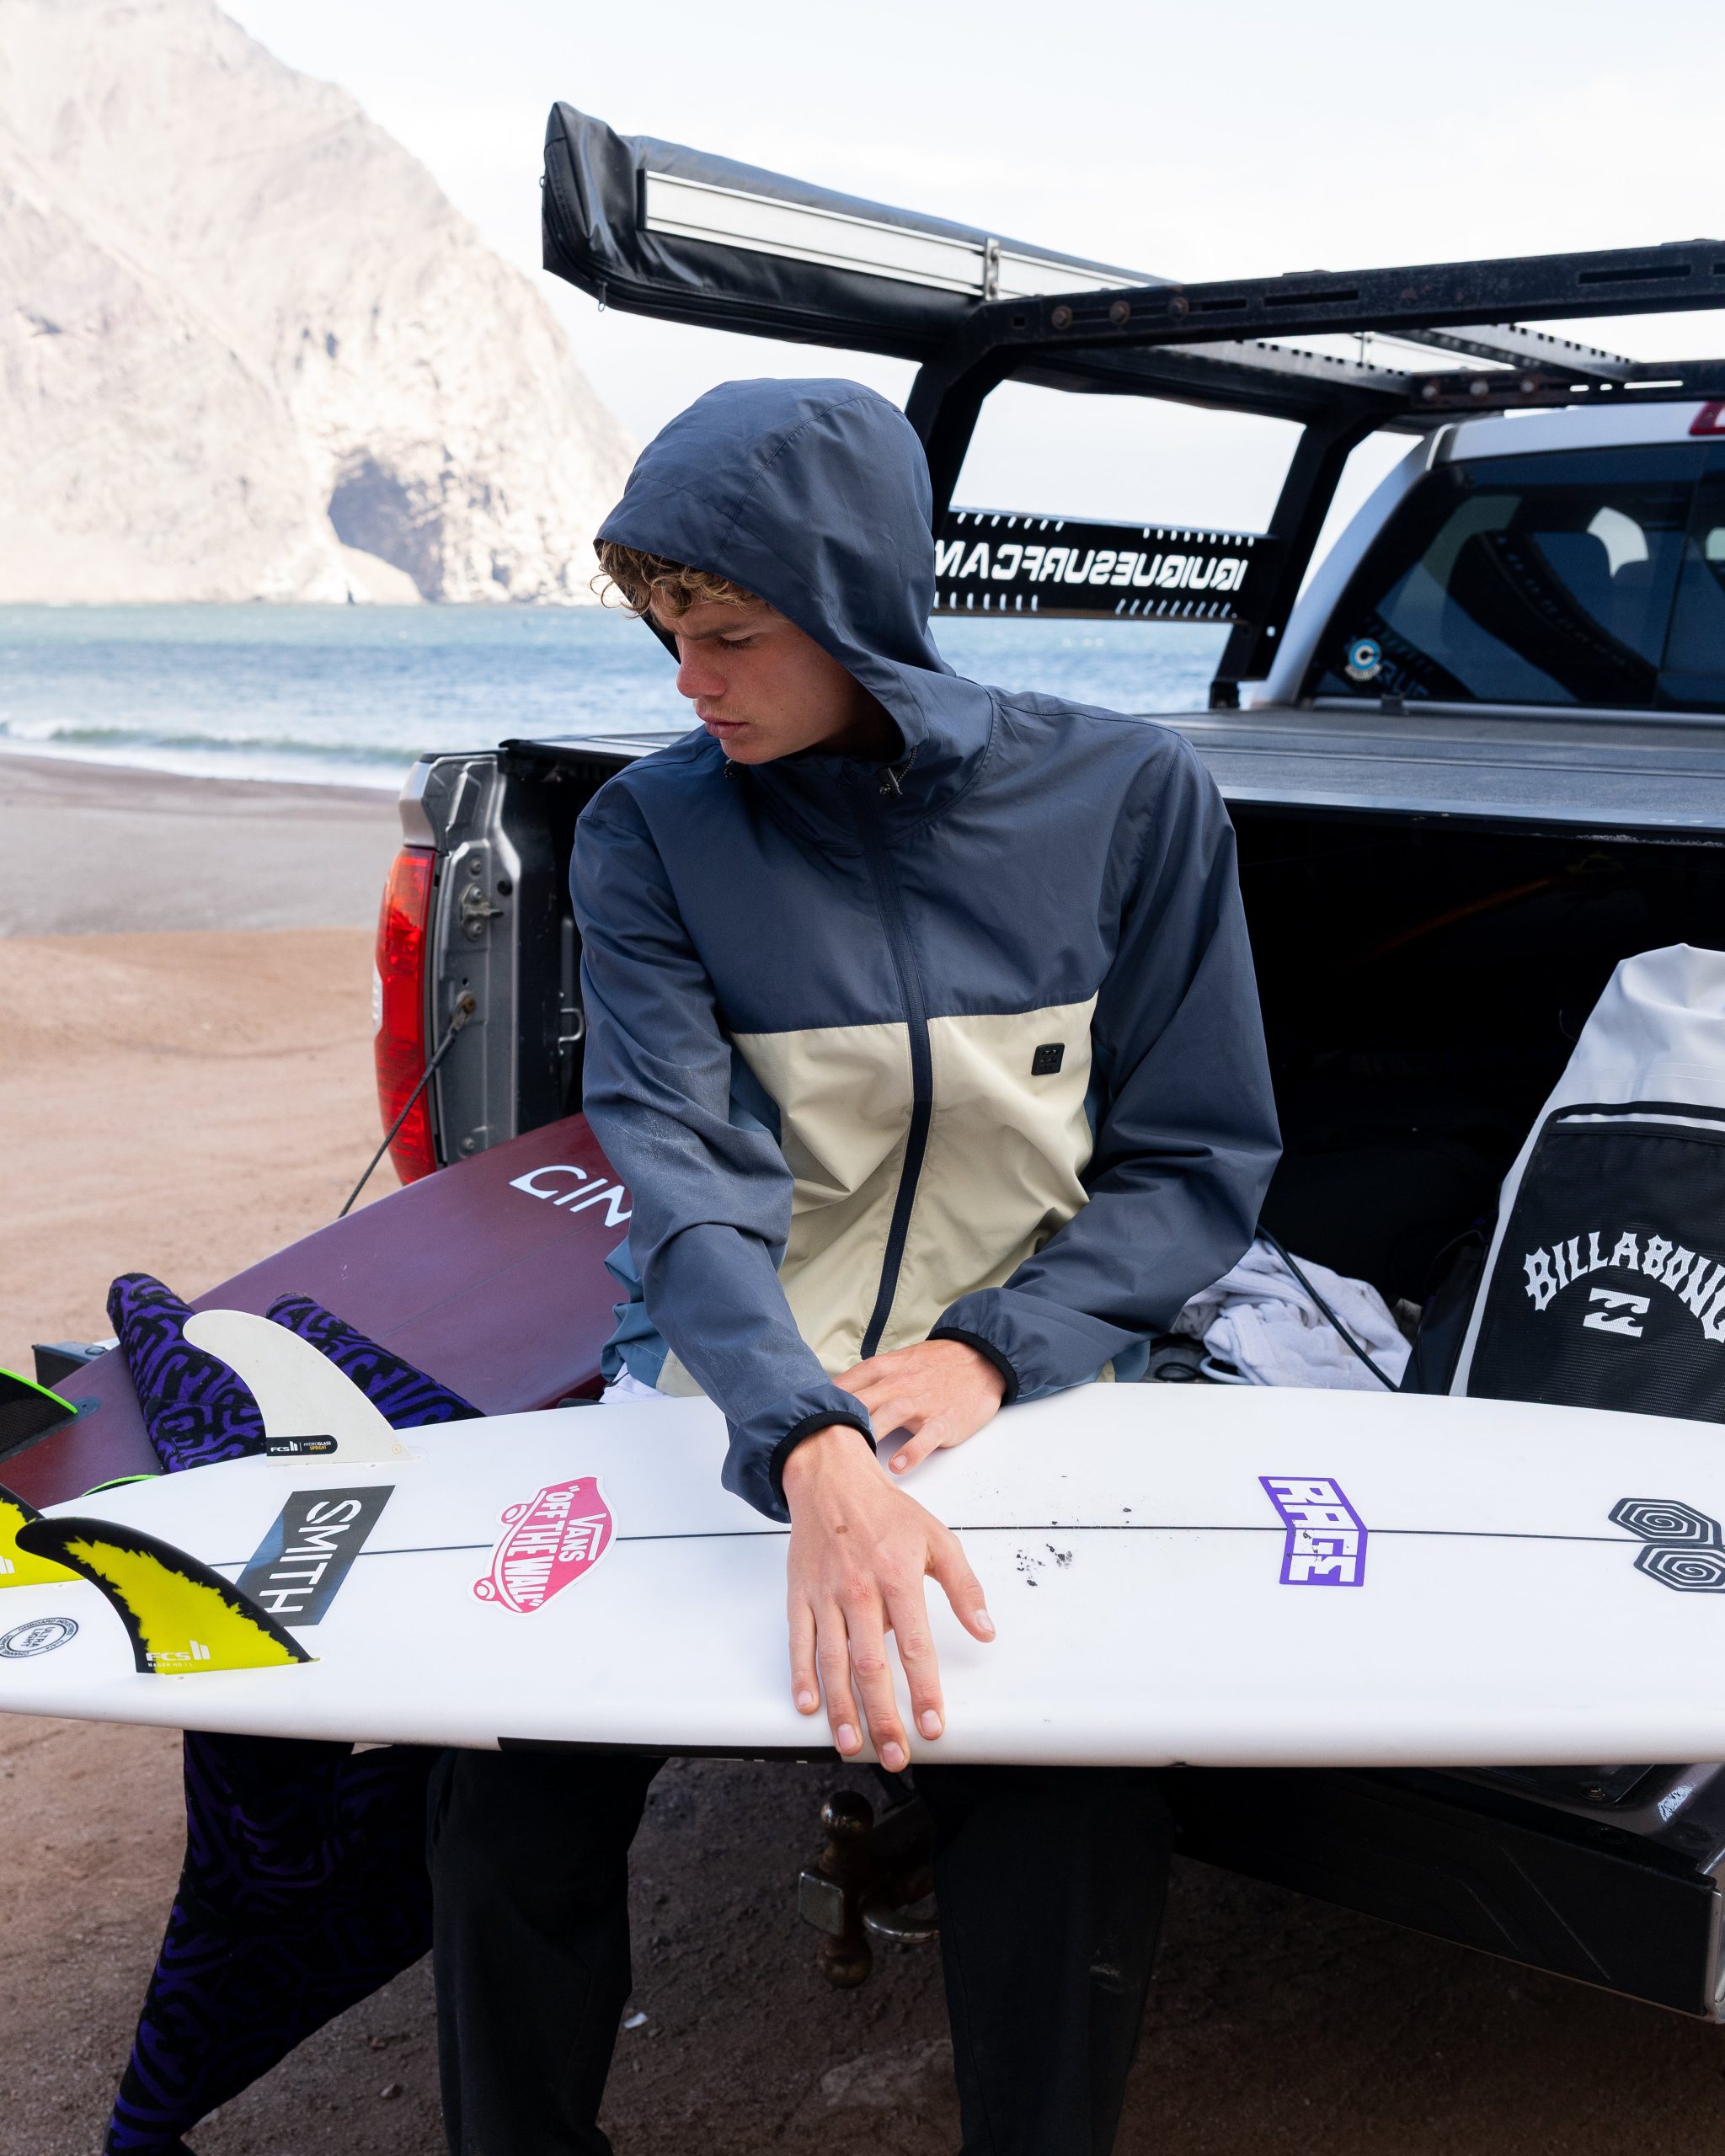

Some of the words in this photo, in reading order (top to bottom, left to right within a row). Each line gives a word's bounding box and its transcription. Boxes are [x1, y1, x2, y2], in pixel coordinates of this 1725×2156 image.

[259, 1499, 362, 1614] SMITH
[506, 1520, 566, 1557] THE
[558, 1513, 607, 1561] VANS
[146, 1652, 190, 1662] FCS
